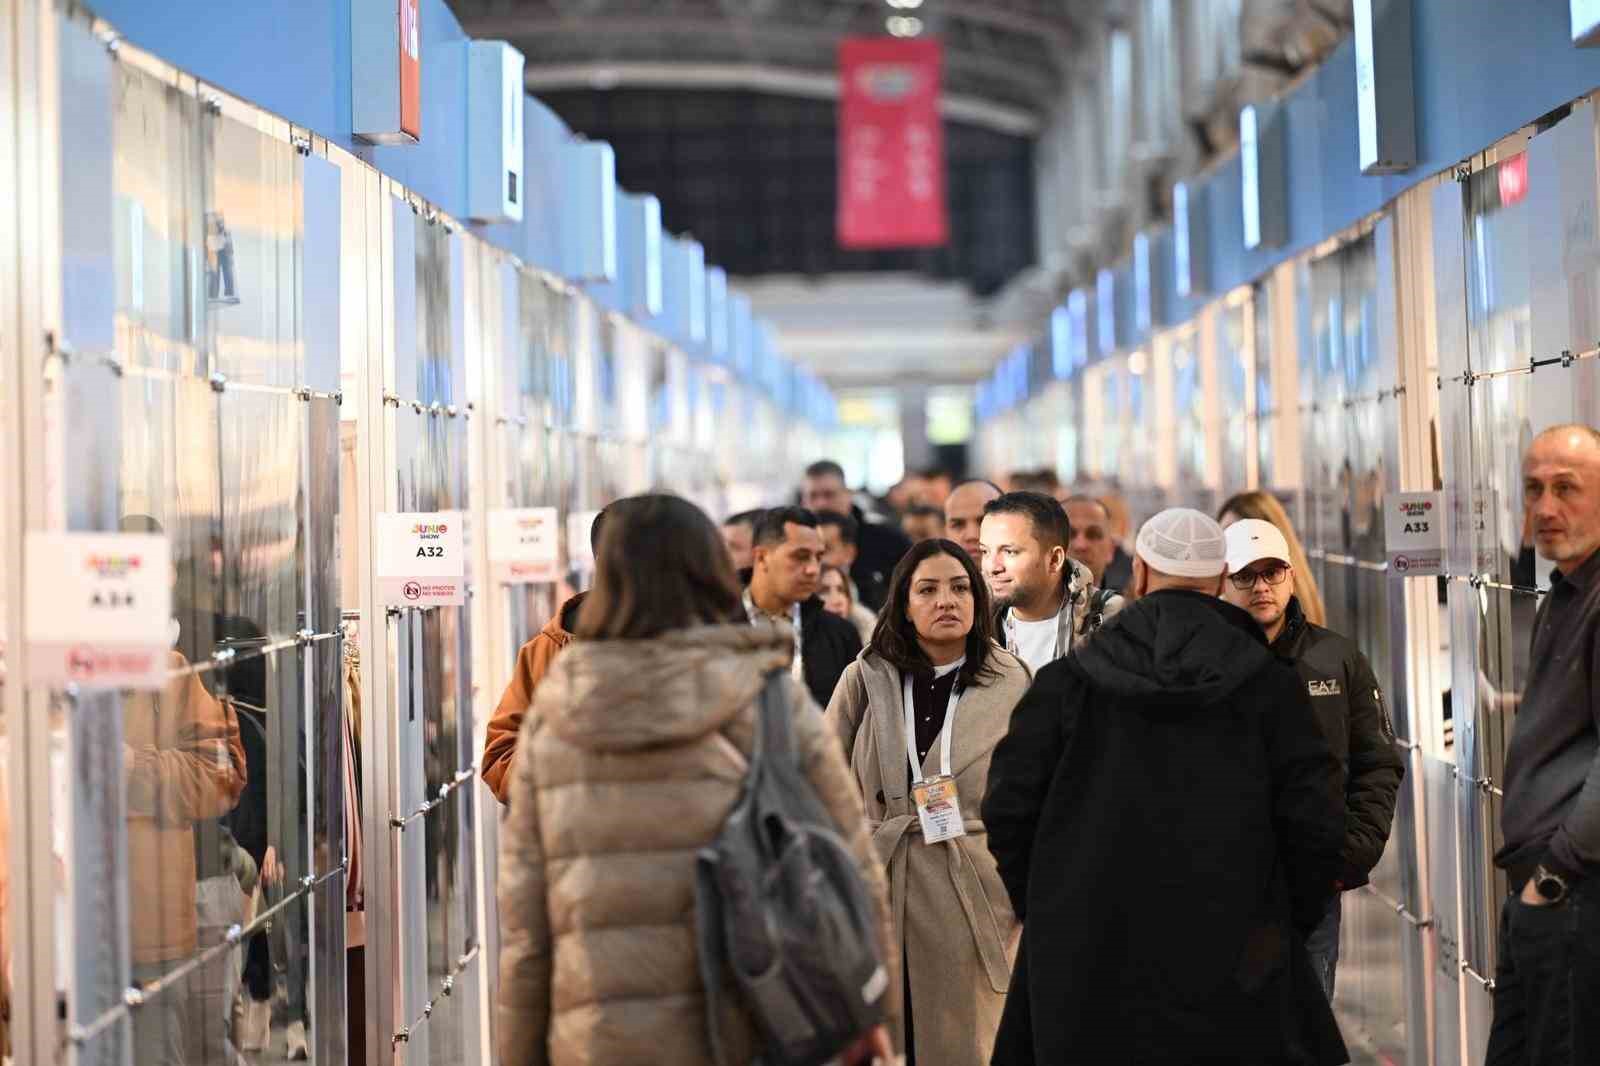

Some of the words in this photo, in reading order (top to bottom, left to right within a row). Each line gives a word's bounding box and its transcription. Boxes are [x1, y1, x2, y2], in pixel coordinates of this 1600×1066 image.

[1404, 522, 1429, 533] A33
[416, 546, 444, 557] A32
[1308, 679, 1338, 692] EA7
